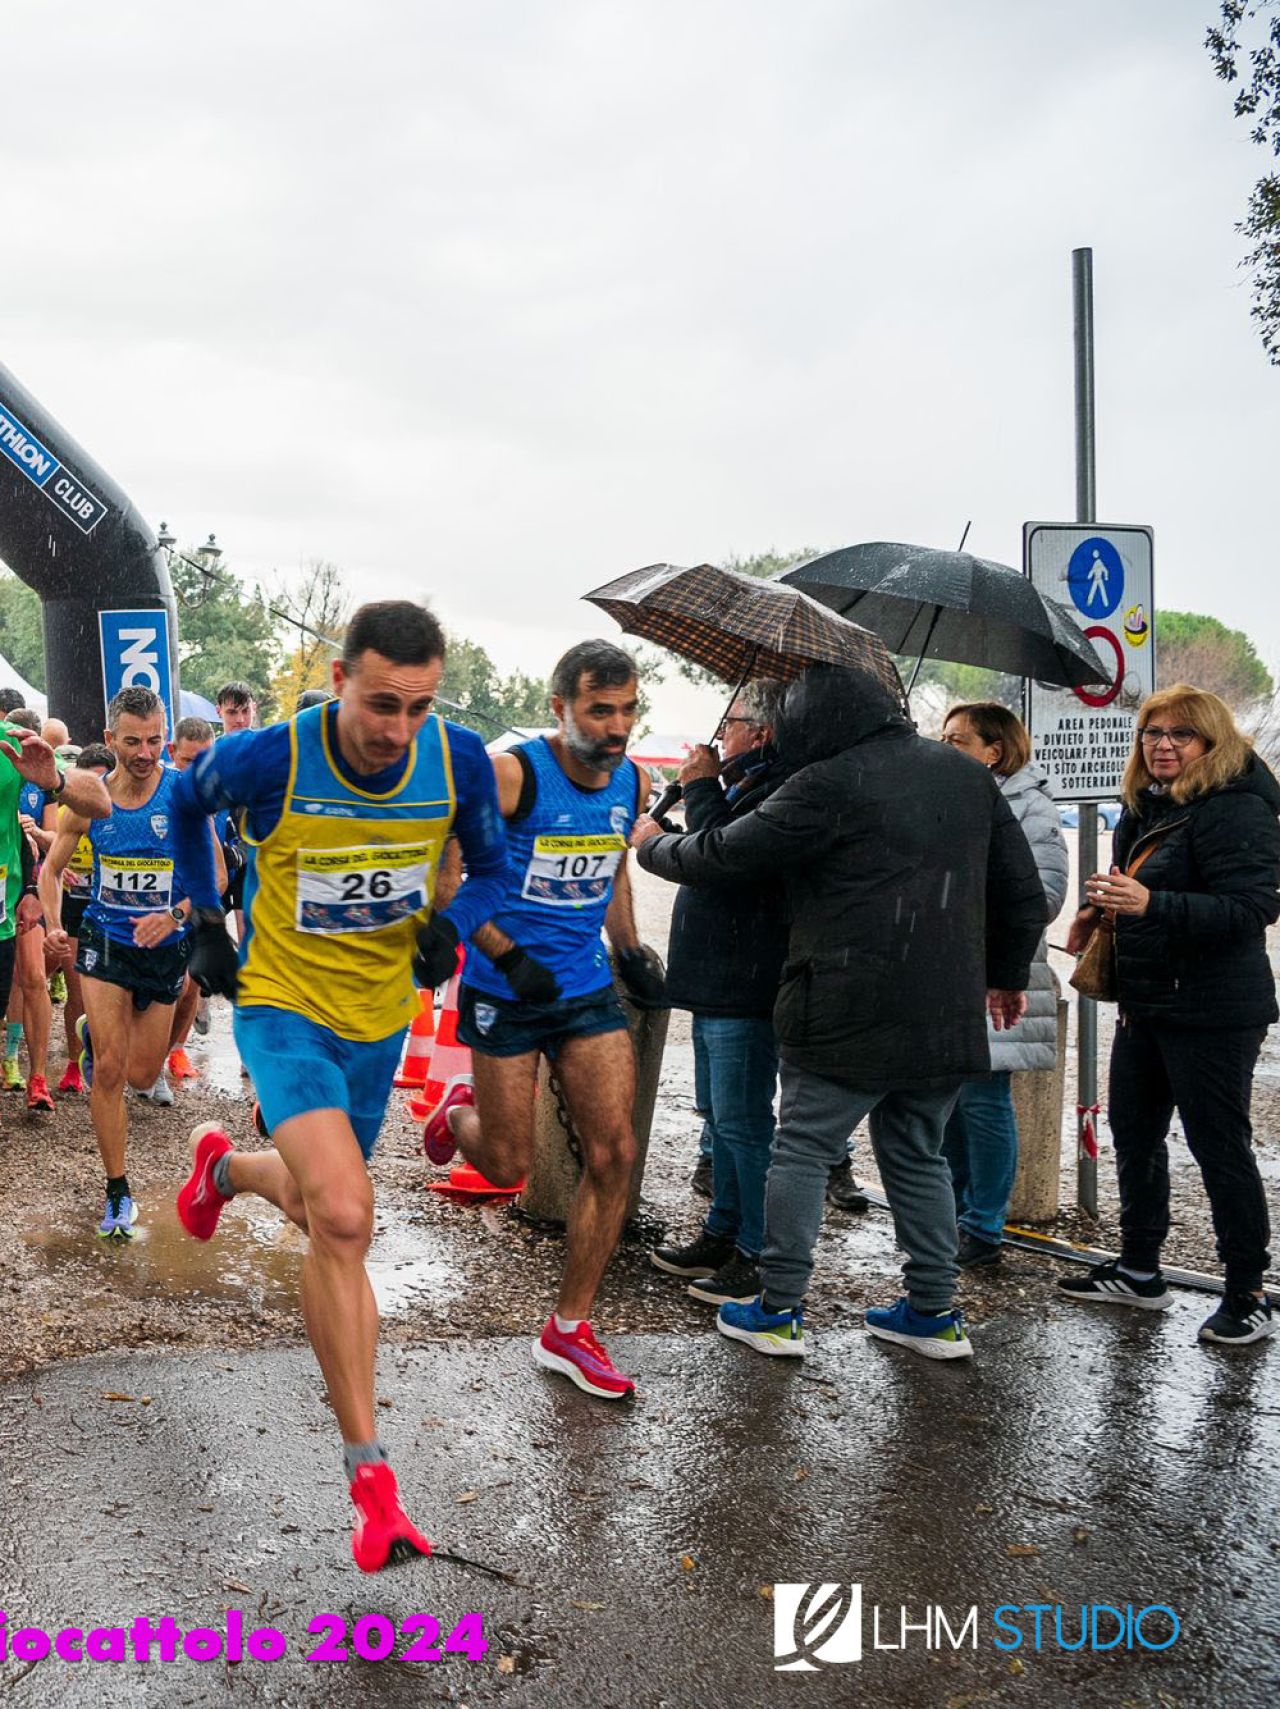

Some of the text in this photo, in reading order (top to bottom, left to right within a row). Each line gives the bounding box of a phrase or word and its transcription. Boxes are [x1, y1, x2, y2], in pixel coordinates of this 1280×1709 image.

[54, 478, 96, 520] CLUB
[1058, 716, 1133, 731] AREA PEDONALE
[1043, 732, 1084, 746] DIVIETO
[1089, 732, 1099, 744] DI
[1091, 746, 1107, 759] PER
[1110, 745, 1130, 758] PRES
[1054, 762, 1077, 774] SITO
[1081, 760, 1125, 774] ARCHEOLO
[556, 855, 608, 877] 107
[113, 872, 157, 890] 112
[340, 870, 393, 901] 26
